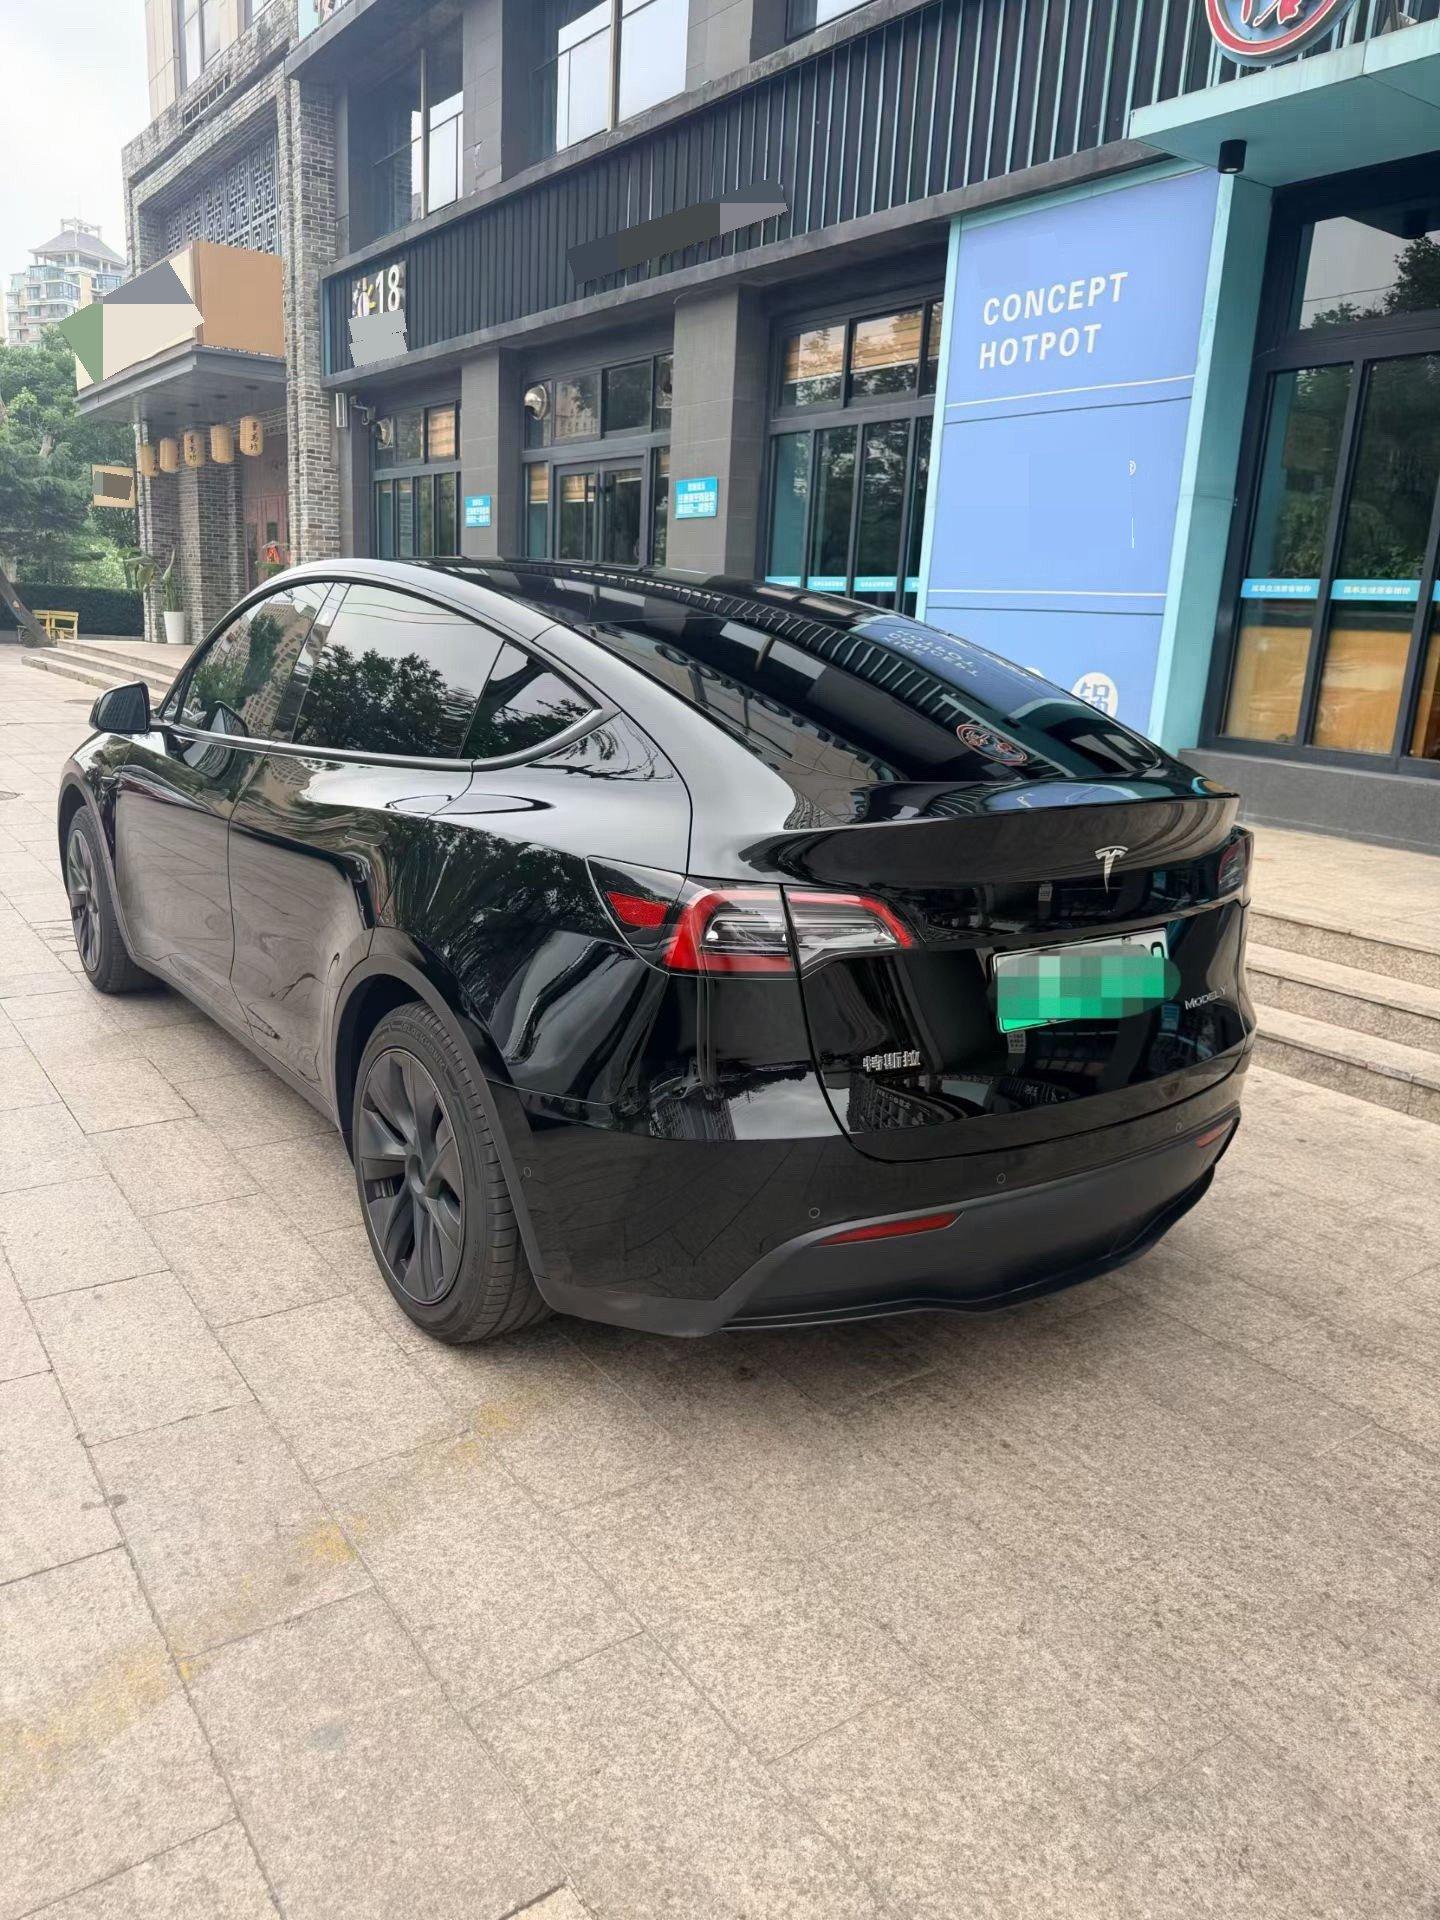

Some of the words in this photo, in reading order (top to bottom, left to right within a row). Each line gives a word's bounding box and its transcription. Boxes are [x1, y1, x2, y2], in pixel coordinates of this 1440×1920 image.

[983, 271, 1129, 326] CONCEPT
[978, 322, 1102, 370] HOTPOT
[862, 1049, 921, 1073] 特斯拉
